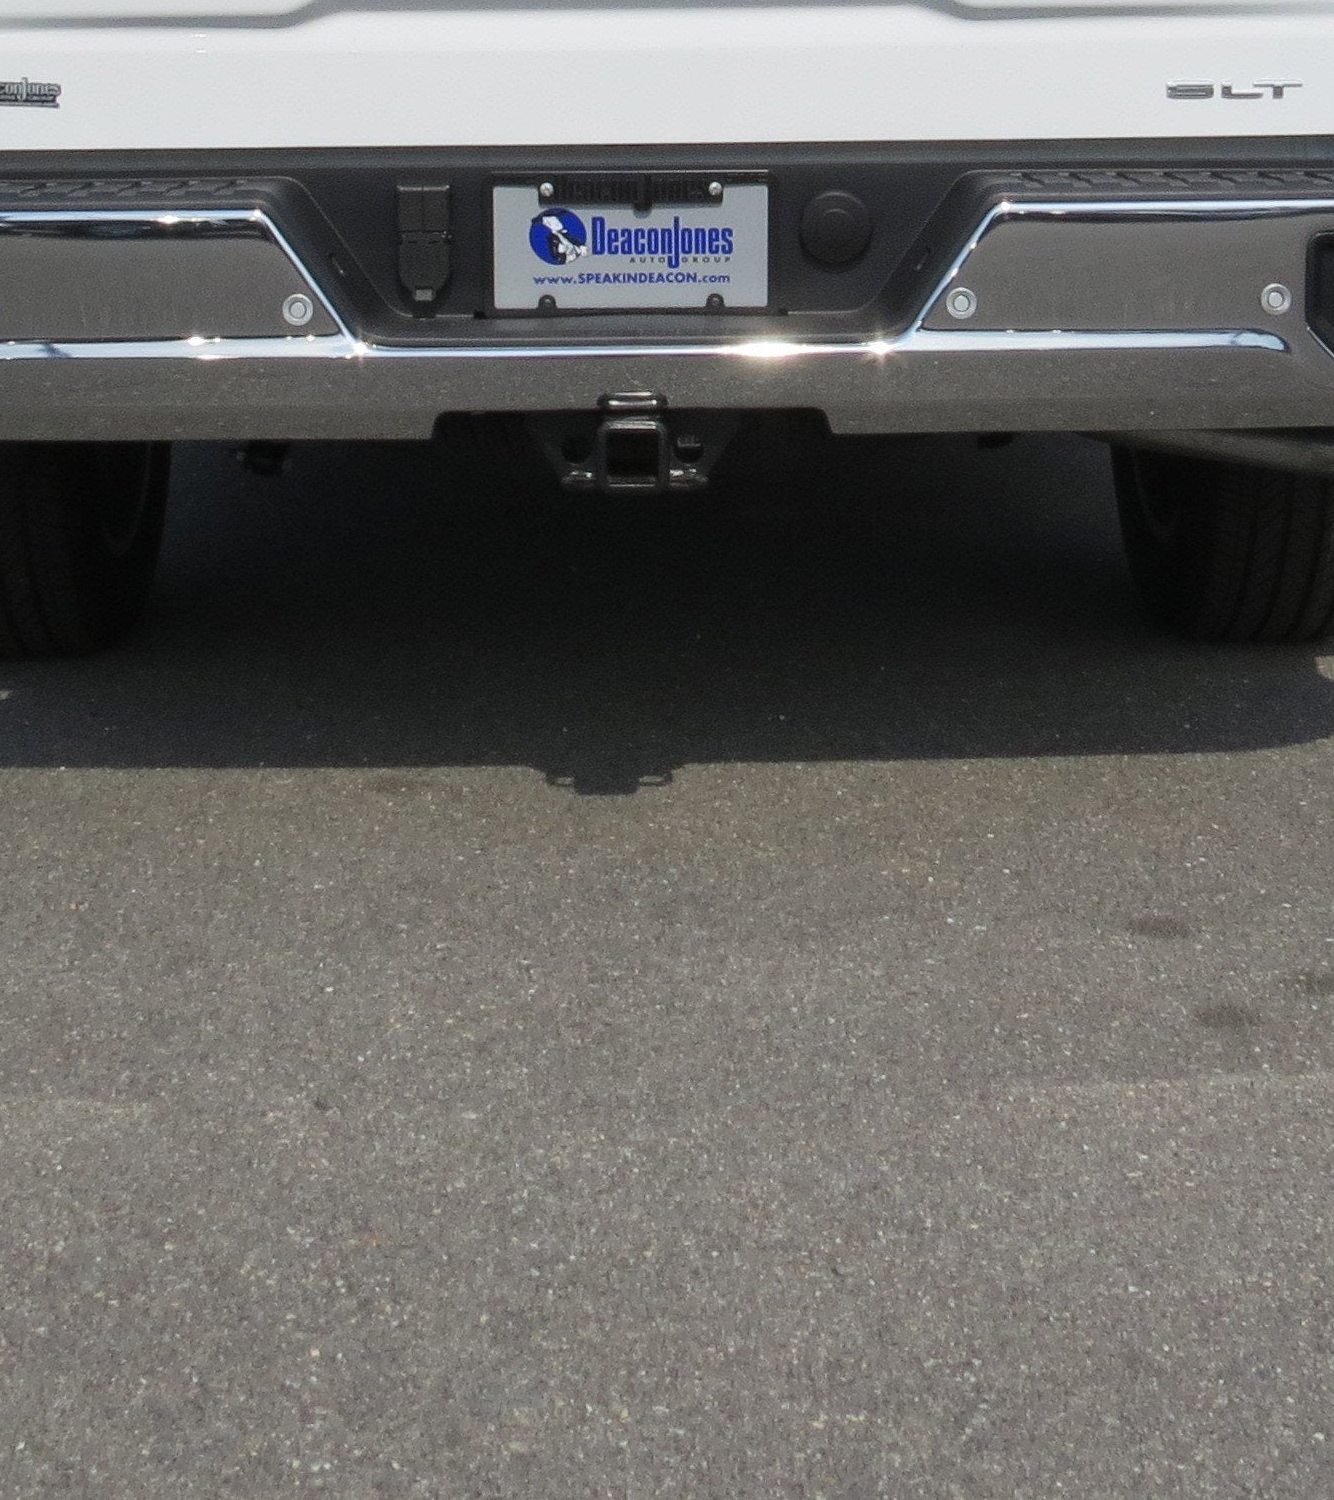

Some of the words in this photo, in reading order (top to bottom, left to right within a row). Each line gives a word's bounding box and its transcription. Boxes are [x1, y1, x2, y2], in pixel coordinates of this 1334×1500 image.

[1167, 79, 1303, 99] SLT
[591, 216, 734, 269] DeaconJones
[533, 272, 731, 285] www.SPEAKINDEACON.com
